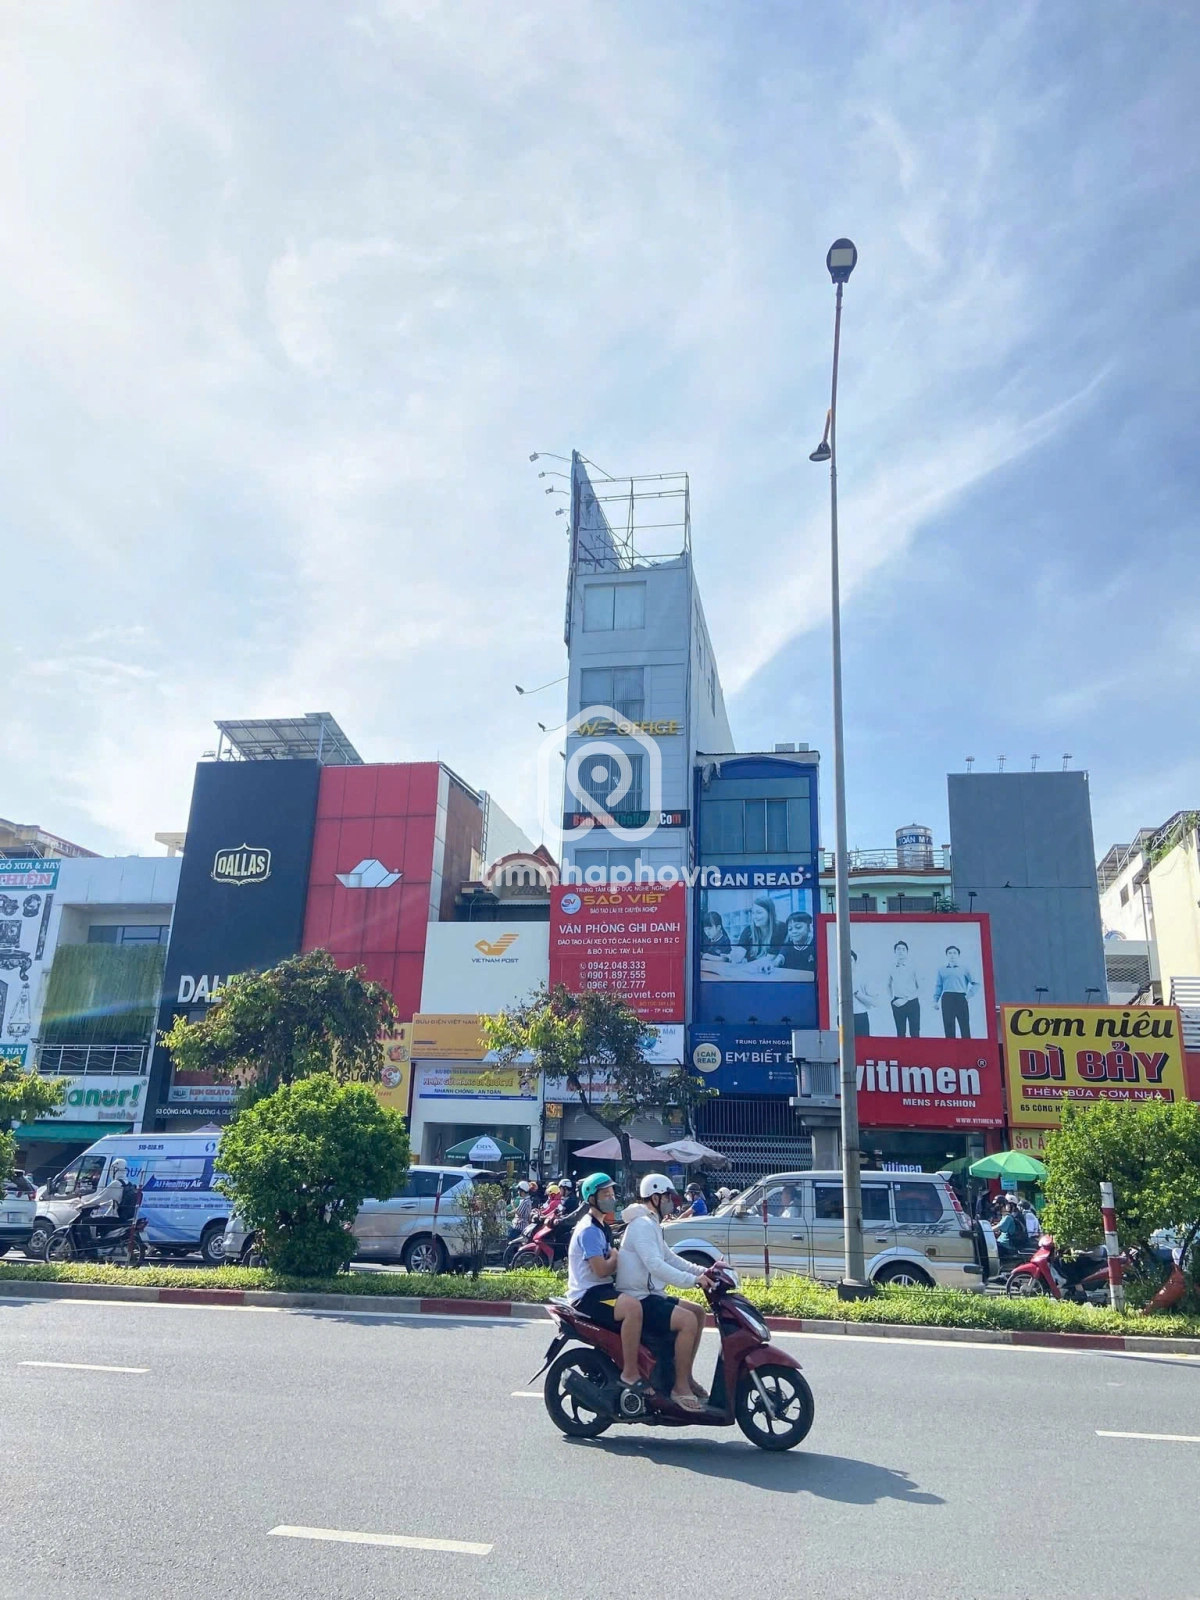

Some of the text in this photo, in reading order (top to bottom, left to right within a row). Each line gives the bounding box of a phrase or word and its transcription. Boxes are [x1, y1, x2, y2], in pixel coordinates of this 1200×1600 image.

[615, 719, 679, 736] OFFICE
[34, 862, 42, 870] &
[43, 861, 61, 870] NAY
[217, 853, 266, 877] DALLAS
[709, 873, 749, 886] CAN
[753, 872, 804, 886] READ
[622, 885, 633, 893] DỤC
[583, 891, 666, 906] SAO VIỆT
[559, 921, 680, 934] VĂN PHÒNG GHI DANH
[605, 947, 618, 955] TÚC
[588, 961, 647, 970] 0942.048.333
[587, 971, 647, 980] 0901.897.555
[587, 981, 647, 989] 0966102.777
[1010, 1008, 1174, 1039] Cơm niêu
[6, 1047, 26, 1055] NAY
[725, 1051, 746, 1062] EM
[751, 1048, 782, 1063] BIẾT
[1019, 1041, 1169, 1083] DÌ BẢY
[205, 1088, 230, 1096] GELATO
[1026, 1087, 1163, 1099] THÈM BỮA CƠM NHÀ
[902, 1098, 976, 1108] MENS FASHION
[1020, 1104, 1030, 1112] 65
[163, 1107, 179, 1116] CỘNG
[956, 1117, 1002, 1125] WWW.VITIMEN.VN
[882, 1161, 922, 1173] vitimen
[162, 1180, 190, 1190] Healthy
[191, 1180, 203, 1188] Air
